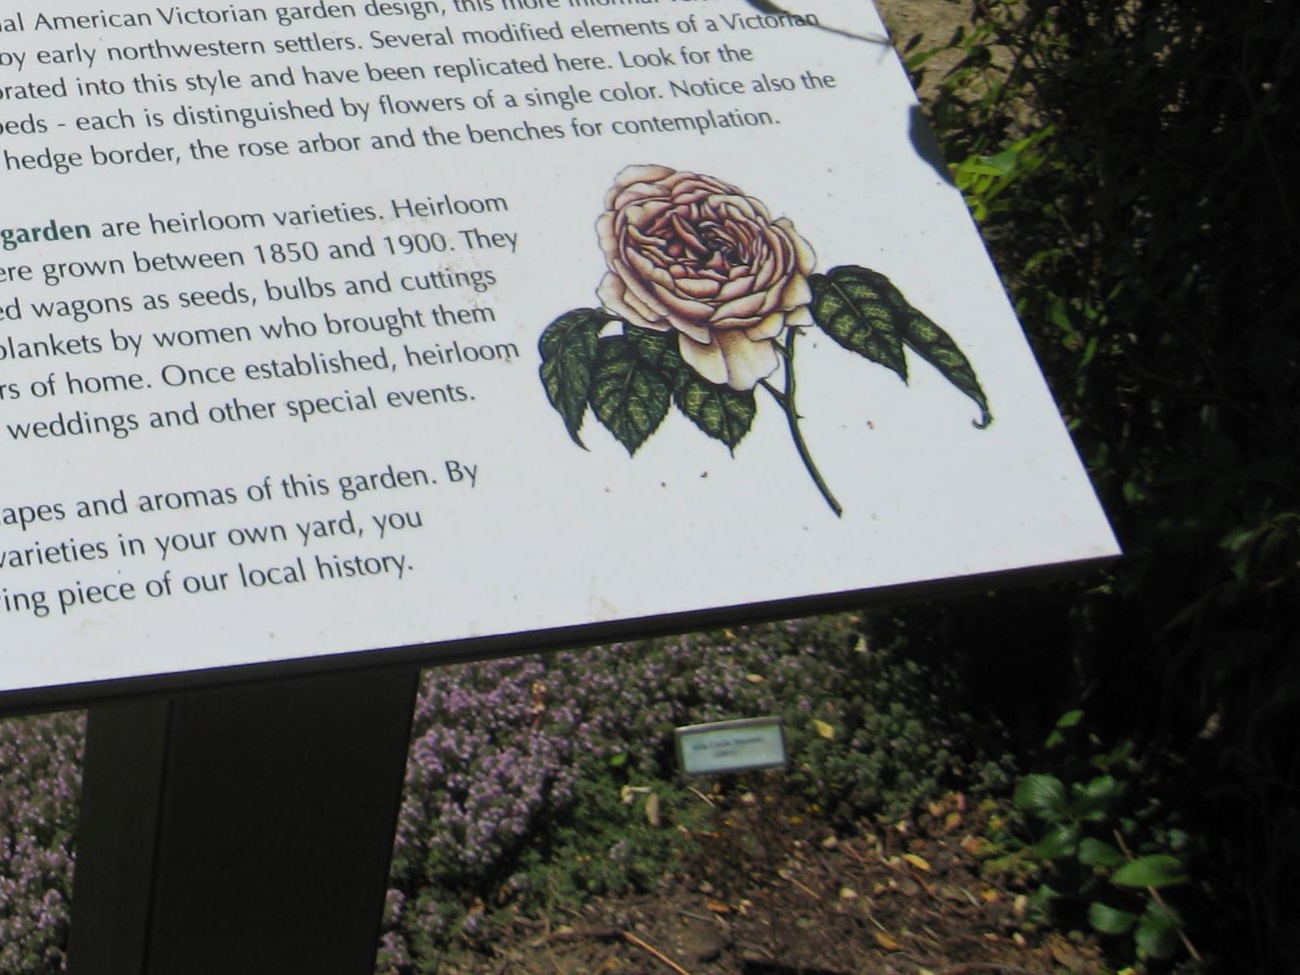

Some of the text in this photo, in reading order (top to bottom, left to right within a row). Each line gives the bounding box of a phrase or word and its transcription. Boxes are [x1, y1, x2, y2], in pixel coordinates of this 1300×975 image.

[34, 9, 153, 31] American
[155, 4, 268, 26] Victorian
[275, 0, 357, 27] garden
[36, 42, 97, 69] early
[106, 38, 266, 61] northwestern
[273, 32, 363, 54] settlers.
[369, 25, 454, 49] Several
[461, 20, 564, 45] modified
[570, 19, 671, 39] elements
[675, 13, 698, 34] of
[704, 19, 720, 32] a
[720, 12, 819, 32] Victorian
[75, 77, 125, 97] into
[132, 72, 178, 94] this
[185, 69, 242, 96] style
[250, 65, 296, 88] and
[301, 65, 360, 85] have
[364, 62, 426, 82] been
[433, 53, 549, 84] replicated
[552, 52, 613, 72] here.
[617, 47, 677, 69] Look
[679, 45, 711, 65] for
[717, 43, 754, 63] the
[75, 108, 136, 132] each
[143, 108, 165, 127] is
[172, 97, 335, 129] distinguished
[339, 96, 370, 123] by
[378, 94, 466, 115] flowers
[472, 88, 496, 110] of
[503, 94, 519, 108] a
[524, 84, 593, 111] single
[599, 80, 664, 103] color.
[668, 77, 746, 98] Notice
[751, 73, 796, 93] also
[800, 70, 837, 90] the
[3, 146, 83, 175] hedge
[89, 141, 181, 166] border,
[188, 138, 229, 160] the
[237, 140, 290, 158] rose
[297, 132, 361, 154] arbor
[370, 126, 416, 150] and
[421, 125, 461, 147] the
[465, 120, 566, 144] benches
[570, 117, 603, 137] for
[611, 108, 781, 136] contemplation.
[0, 218, 92, 252] garden
[101, 220, 141, 238] are
[148, 209, 266, 235] heirloom
[272, 202, 385, 226] varieties.
[390, 193, 509, 219] Heirloom
[42, 259, 125, 287] grown
[132, 250, 245, 273] between
[253, 241, 320, 265] 1850
[328, 235, 376, 260] and
[383, 232, 455, 256] 1900.
[457, 227, 518, 254] They
[30, 296, 133, 323] wagons
[142, 293, 170, 311] as
[178, 281, 257, 309] seeds,
[263, 275, 337, 302] bulbs
[344, 270, 393, 296] and
[400, 267, 497, 293] cuttings
[109, 328, 143, 358] by
[152, 326, 252, 348] women
[259, 315, 318, 340] who
[323, 306, 426, 338] brought
[430, 303, 496, 327] them
[30, 372, 56, 398] of
[65, 371, 152, 395] home.
[161, 364, 236, 387] Once
[244, 346, 397, 381] established,
[403, 340, 520, 367] heirloom
[6, 410, 140, 440] weddings
[149, 401, 200, 429] and
[208, 397, 276, 424] other
[285, 386, 378, 424] special
[386, 383, 475, 408] events.
[76, 489, 128, 519] and
[138, 487, 238, 513] aromas
[246, 475, 272, 502] of
[280, 473, 330, 499] this
[338, 464, 437, 501] garden.
[444, 459, 478, 489] By
[117, 533, 146, 557] in
[154, 531, 217, 562] your
[227, 524, 288, 546] own
[295, 509, 364, 547] yard,
[371, 511, 423, 540] you
[57, 580, 136, 616] piece
[145, 569, 172, 598] of
[182, 572, 229, 594] our
[237, 556, 307, 588] local
[314, 554, 413, 580] history.
